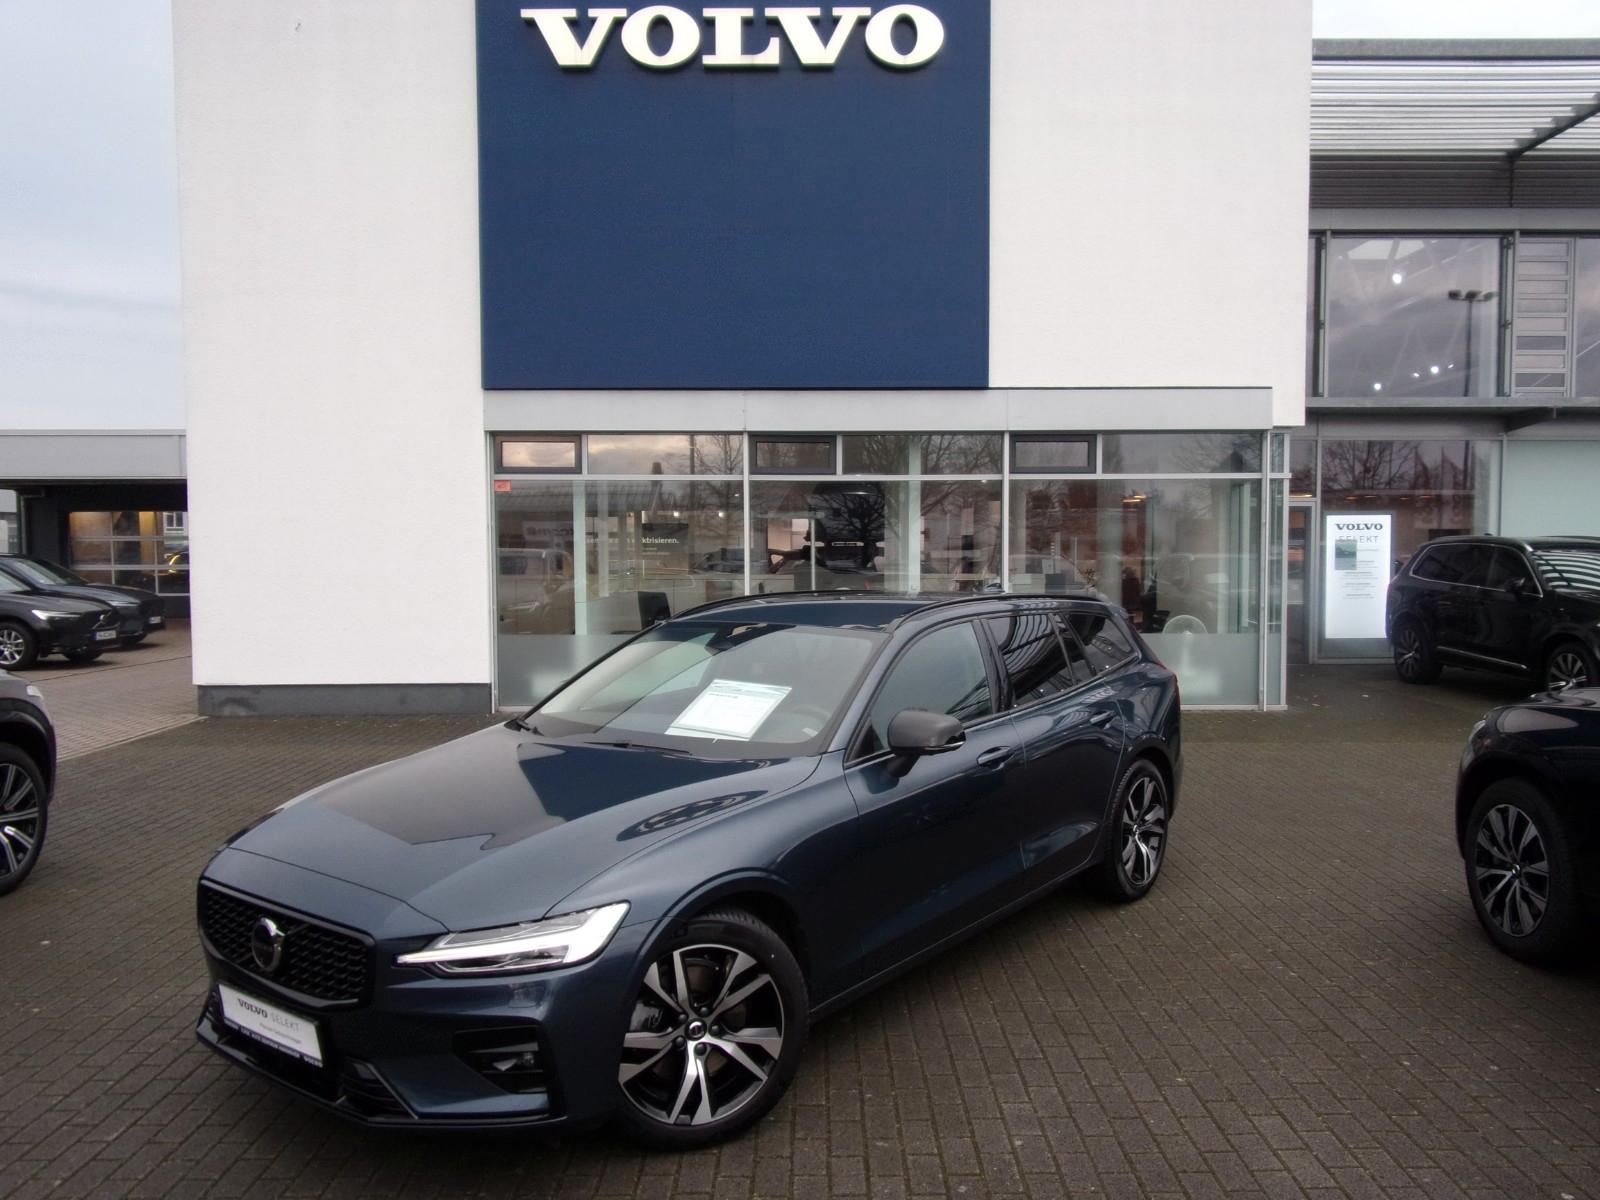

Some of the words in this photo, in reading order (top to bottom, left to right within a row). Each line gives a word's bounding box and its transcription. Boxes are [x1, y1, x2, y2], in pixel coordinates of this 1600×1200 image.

[520, 4, 945, 70] VOLVO
[1335, 523, 1383, 531] VOLVO
[238, 998, 268, 1018] VOLVO
[271, 1013, 300, 1032] SELEKT
